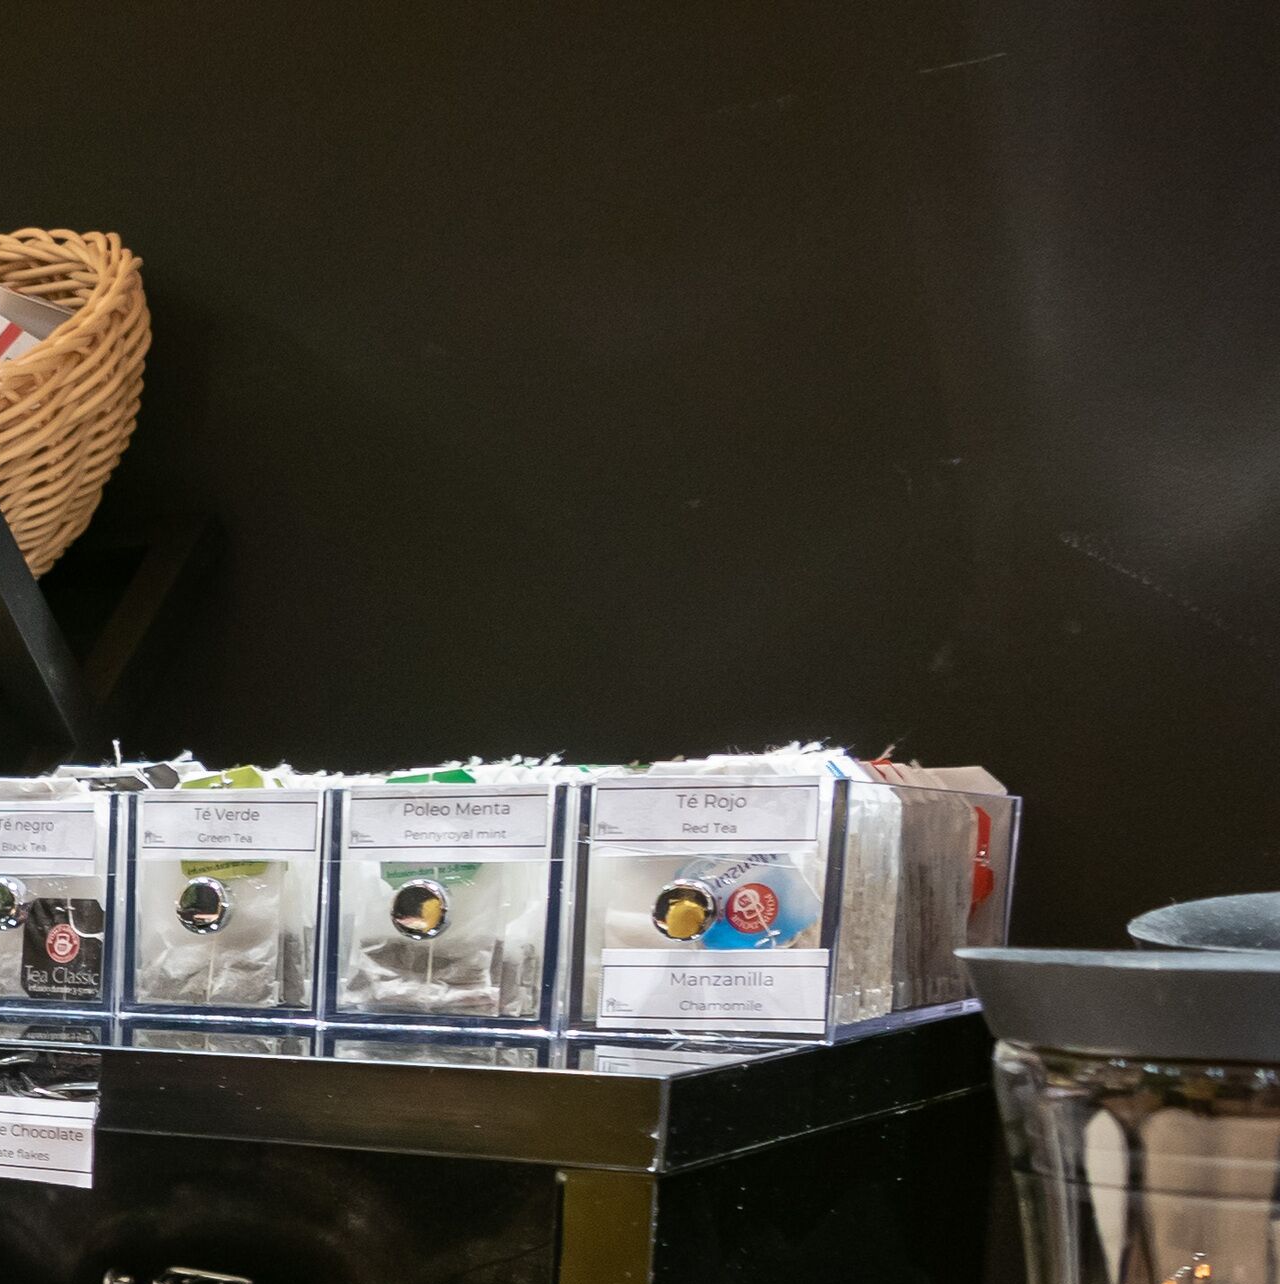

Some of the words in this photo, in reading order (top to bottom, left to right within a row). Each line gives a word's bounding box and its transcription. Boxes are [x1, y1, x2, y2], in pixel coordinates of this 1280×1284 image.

[403, 802, 451, 817] Poleo
[455, 802, 511, 816] Menta
[676, 794, 698, 808] Té
[704, 794, 747, 812] Rojo
[194, 807, 211, 820] Té
[214, 808, 260, 822] Verde
[14, 820, 55, 834] negro
[682, 822, 709, 834] Red
[714, 822, 737, 834] Tea
[198, 833, 231, 843] Green
[234, 834, 253, 844] Tea
[404, 829, 473, 842] Pennyroyal
[476, 829, 507, 839] mint
[1, 842, 28, 852] Black
[30, 842, 47, 852] Tea
[25, 965, 48, 983] Tea
[52, 966, 100, 986] Classic
[670, 971, 774, 988] Manzanilla
[679, 1000, 762, 1012] Chamomile
[10, 1124, 84, 1142] Chocolate
[16, 1148, 50, 1162] flakes
